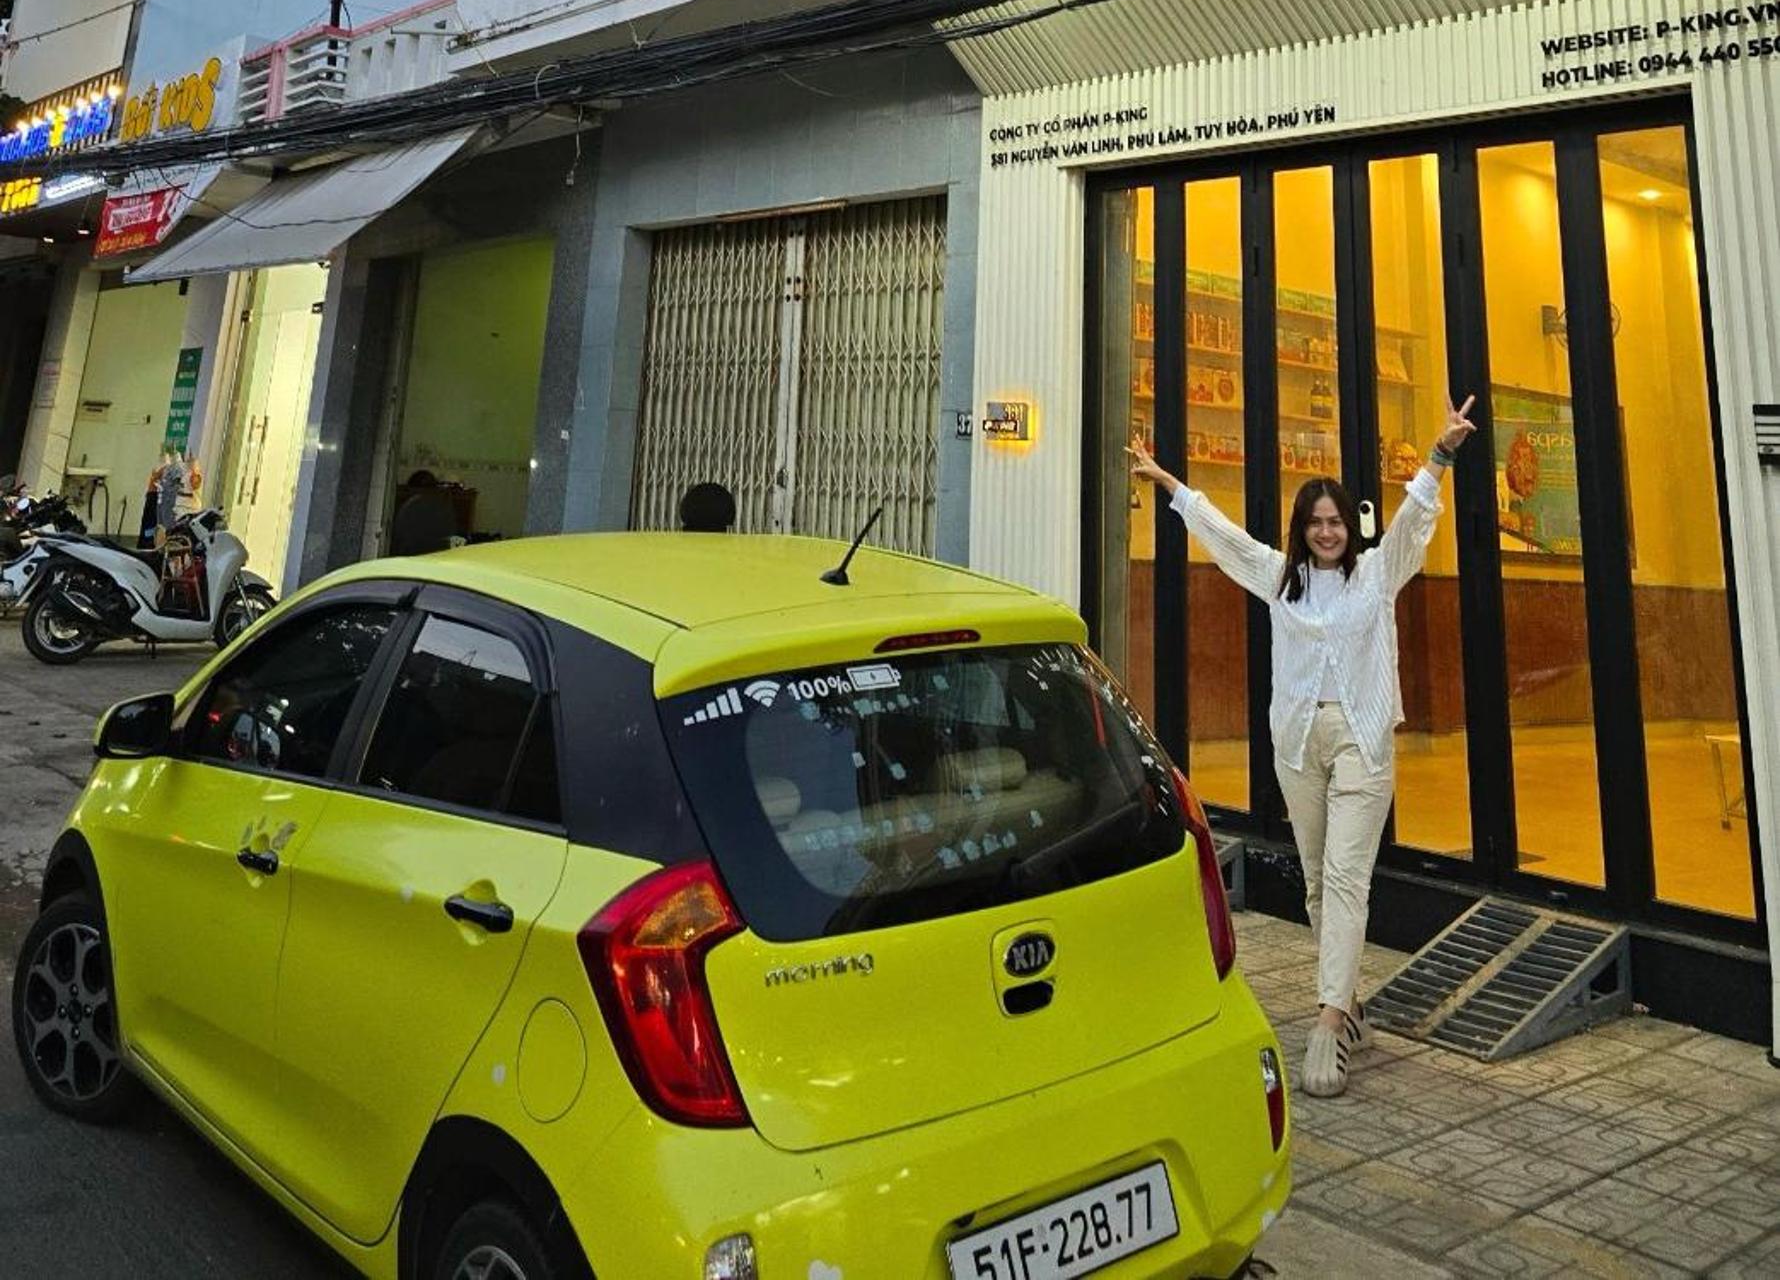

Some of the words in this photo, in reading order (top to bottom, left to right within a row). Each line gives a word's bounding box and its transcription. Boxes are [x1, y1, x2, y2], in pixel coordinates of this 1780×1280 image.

[1540, 24, 1649, 57] WEBSITE:
[1541, 59, 1633, 89] HOTLINE:
[1637, 49, 1694, 73] 0944
[1698, 42, 1741, 65] 440
[1025, 122, 1041, 137] TY
[1102, 106, 1149, 125] P-KING
[1194, 121, 1222, 139] TUY
[786, 675, 853, 701] 100%
[765, 952, 875, 988] morning
[1011, 939, 1051, 972] KIA
